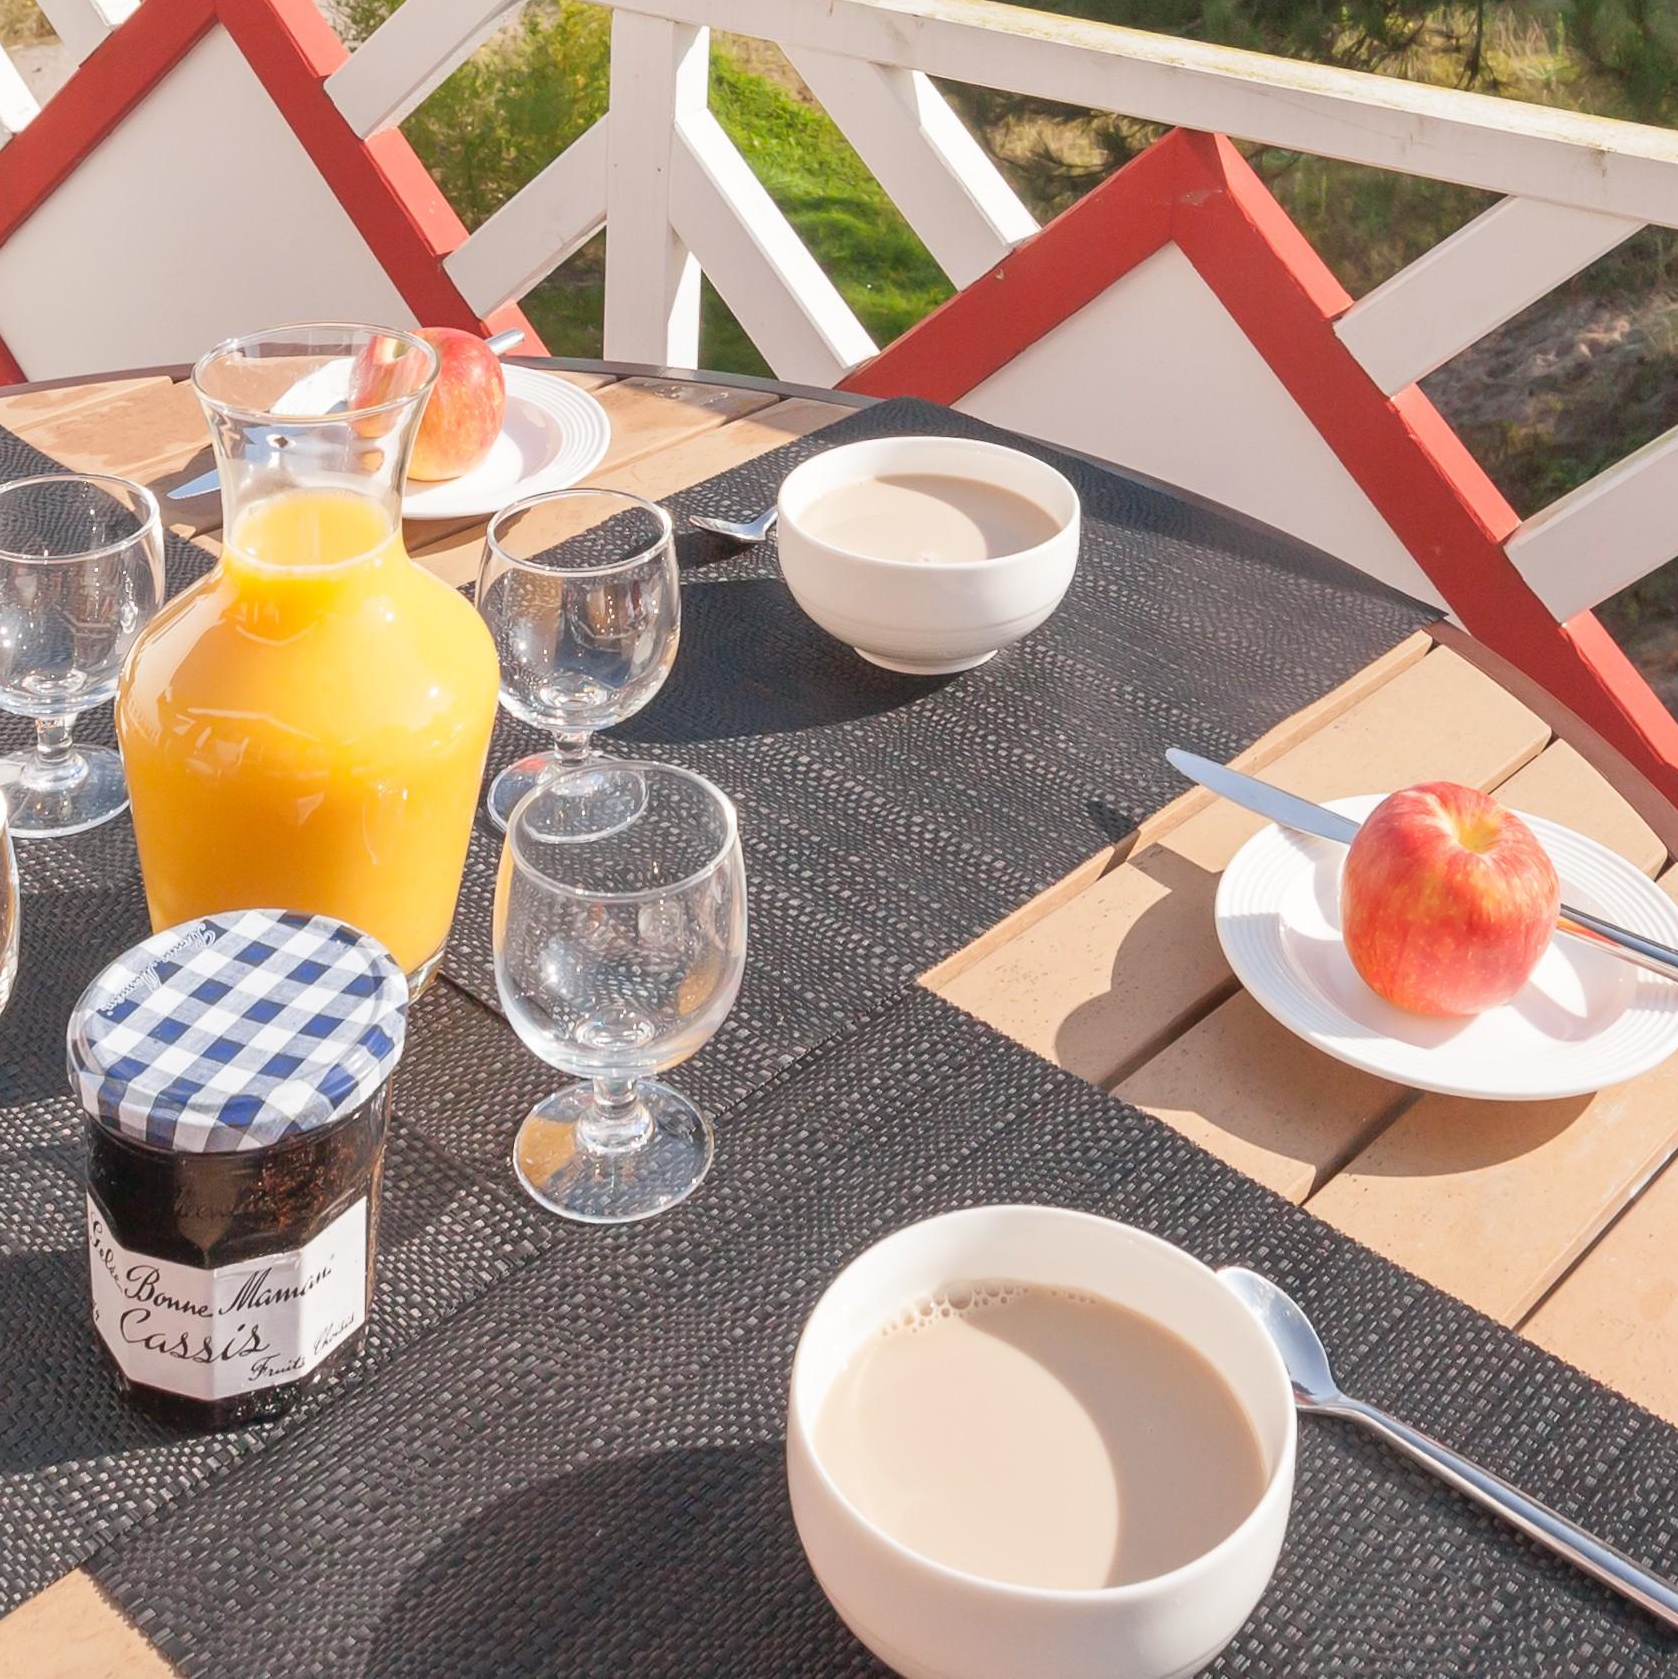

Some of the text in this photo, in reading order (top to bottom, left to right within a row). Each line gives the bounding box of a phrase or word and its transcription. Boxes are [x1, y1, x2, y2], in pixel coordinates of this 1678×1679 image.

[124, 1265, 332, 1318] Bonne Maman
[119, 1308, 271, 1364] Cassis
[248, 1352, 305, 1382] Fruits
